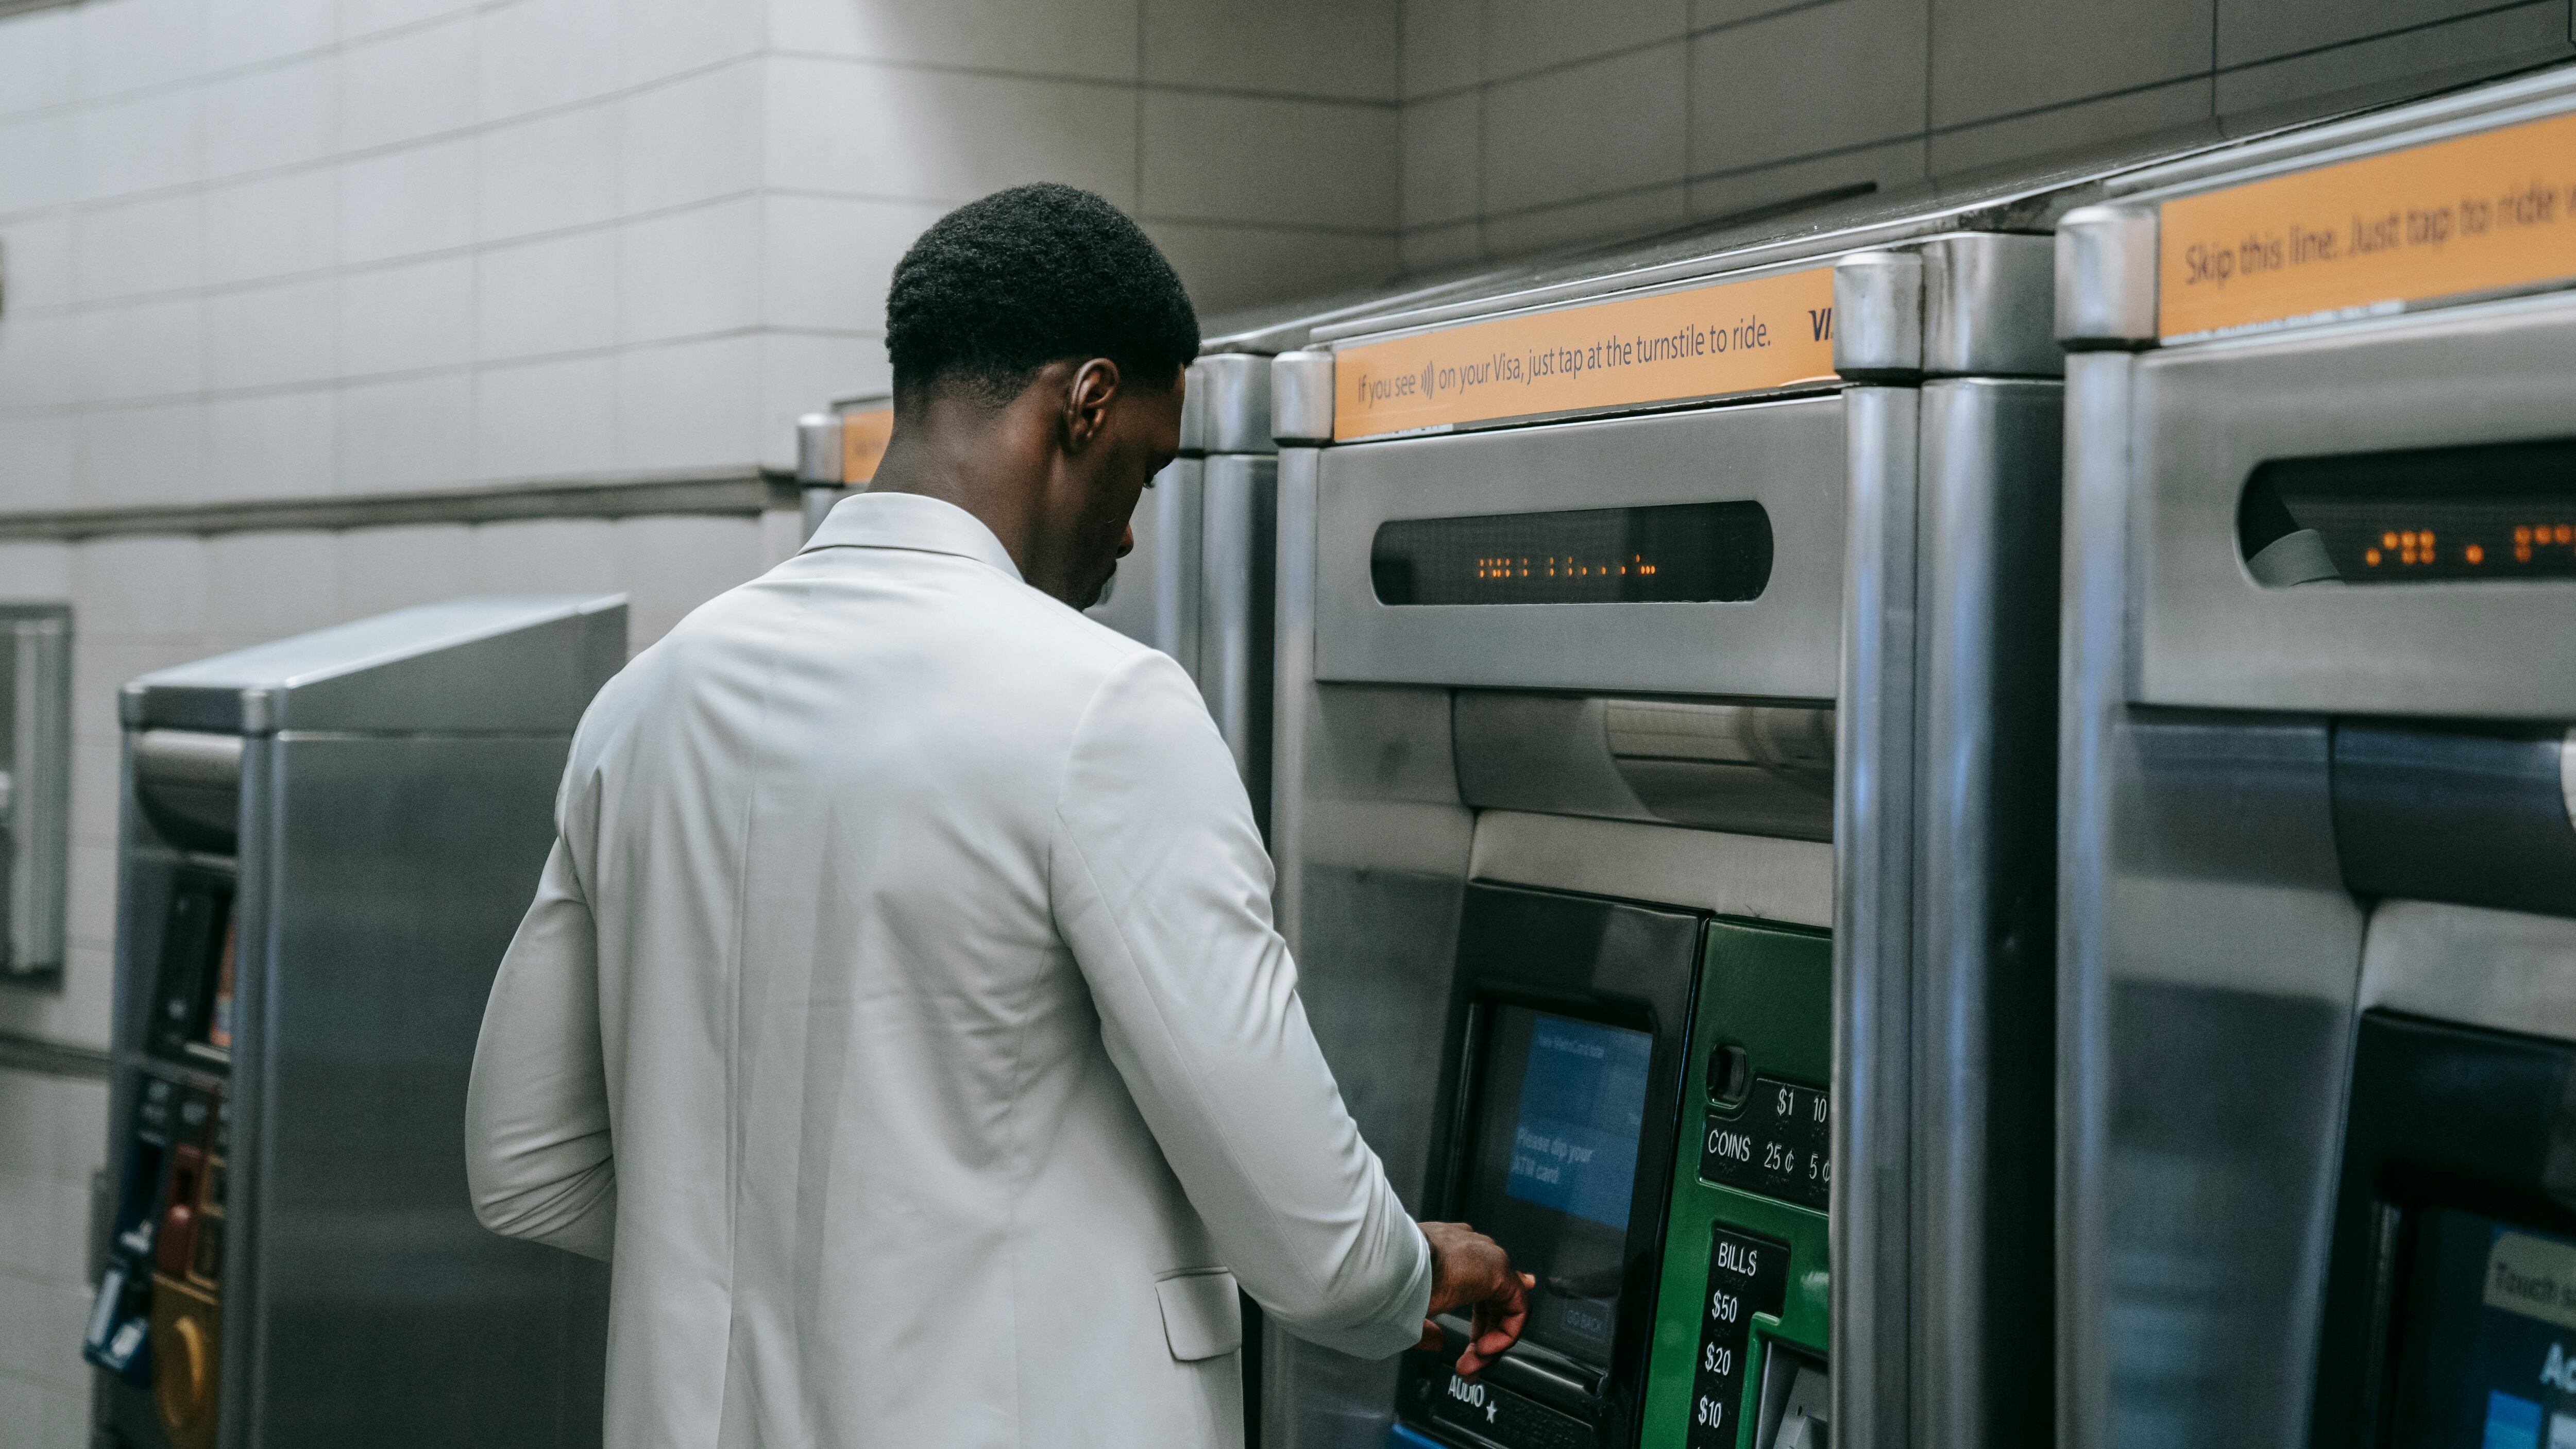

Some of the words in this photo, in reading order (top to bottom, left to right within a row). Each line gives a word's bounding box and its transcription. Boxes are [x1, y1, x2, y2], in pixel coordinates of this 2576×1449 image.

[2185, 243, 2235, 290] Skip
[2239, 233, 2283, 275] this
[2347, 213, 2402, 257] Just
[2406, 207, 2452, 248] tap
[2459, 195, 2488, 234] to
[2496, 175, 2555, 226] ride
[1808, 308, 1833, 341] VI
[1358, 374, 1367, 403] If
[1369, 379, 1391, 409] you
[1395, 374, 1416, 398] see
[1439, 367, 1455, 390] on
[1459, 362, 1490, 395] your
[1493, 353, 1524, 382] Visa,
[1526, 348, 1554, 386] just
[1558, 346, 1583, 380] tap
[1587, 341, 1602, 369] at
[1605, 335, 1632, 365] the
[1637, 324, 1705, 364] turnstile
[1709, 325, 1727, 353] to
[1733, 314, 1771, 351] ride.
[1777, 1087, 1795, 1116] $1
[1814, 1096, 1827, 1123] 10
[1516, 1127, 1550, 1153] Please
[1551, 1138, 1567, 1161] dip
[1567, 1145, 1595, 1164] your
[1708, 1129, 1751, 1162] COINS
[1535, 1165, 1560, 1184] card
[1718, 1242, 1757, 1277] BILLS
[1711, 1289, 1738, 1323] $50
[1704, 1341, 1731, 1376] $20
[1447, 1374, 1485, 1408] AUDIO
[1698, 1394, 1722, 1429] $10
